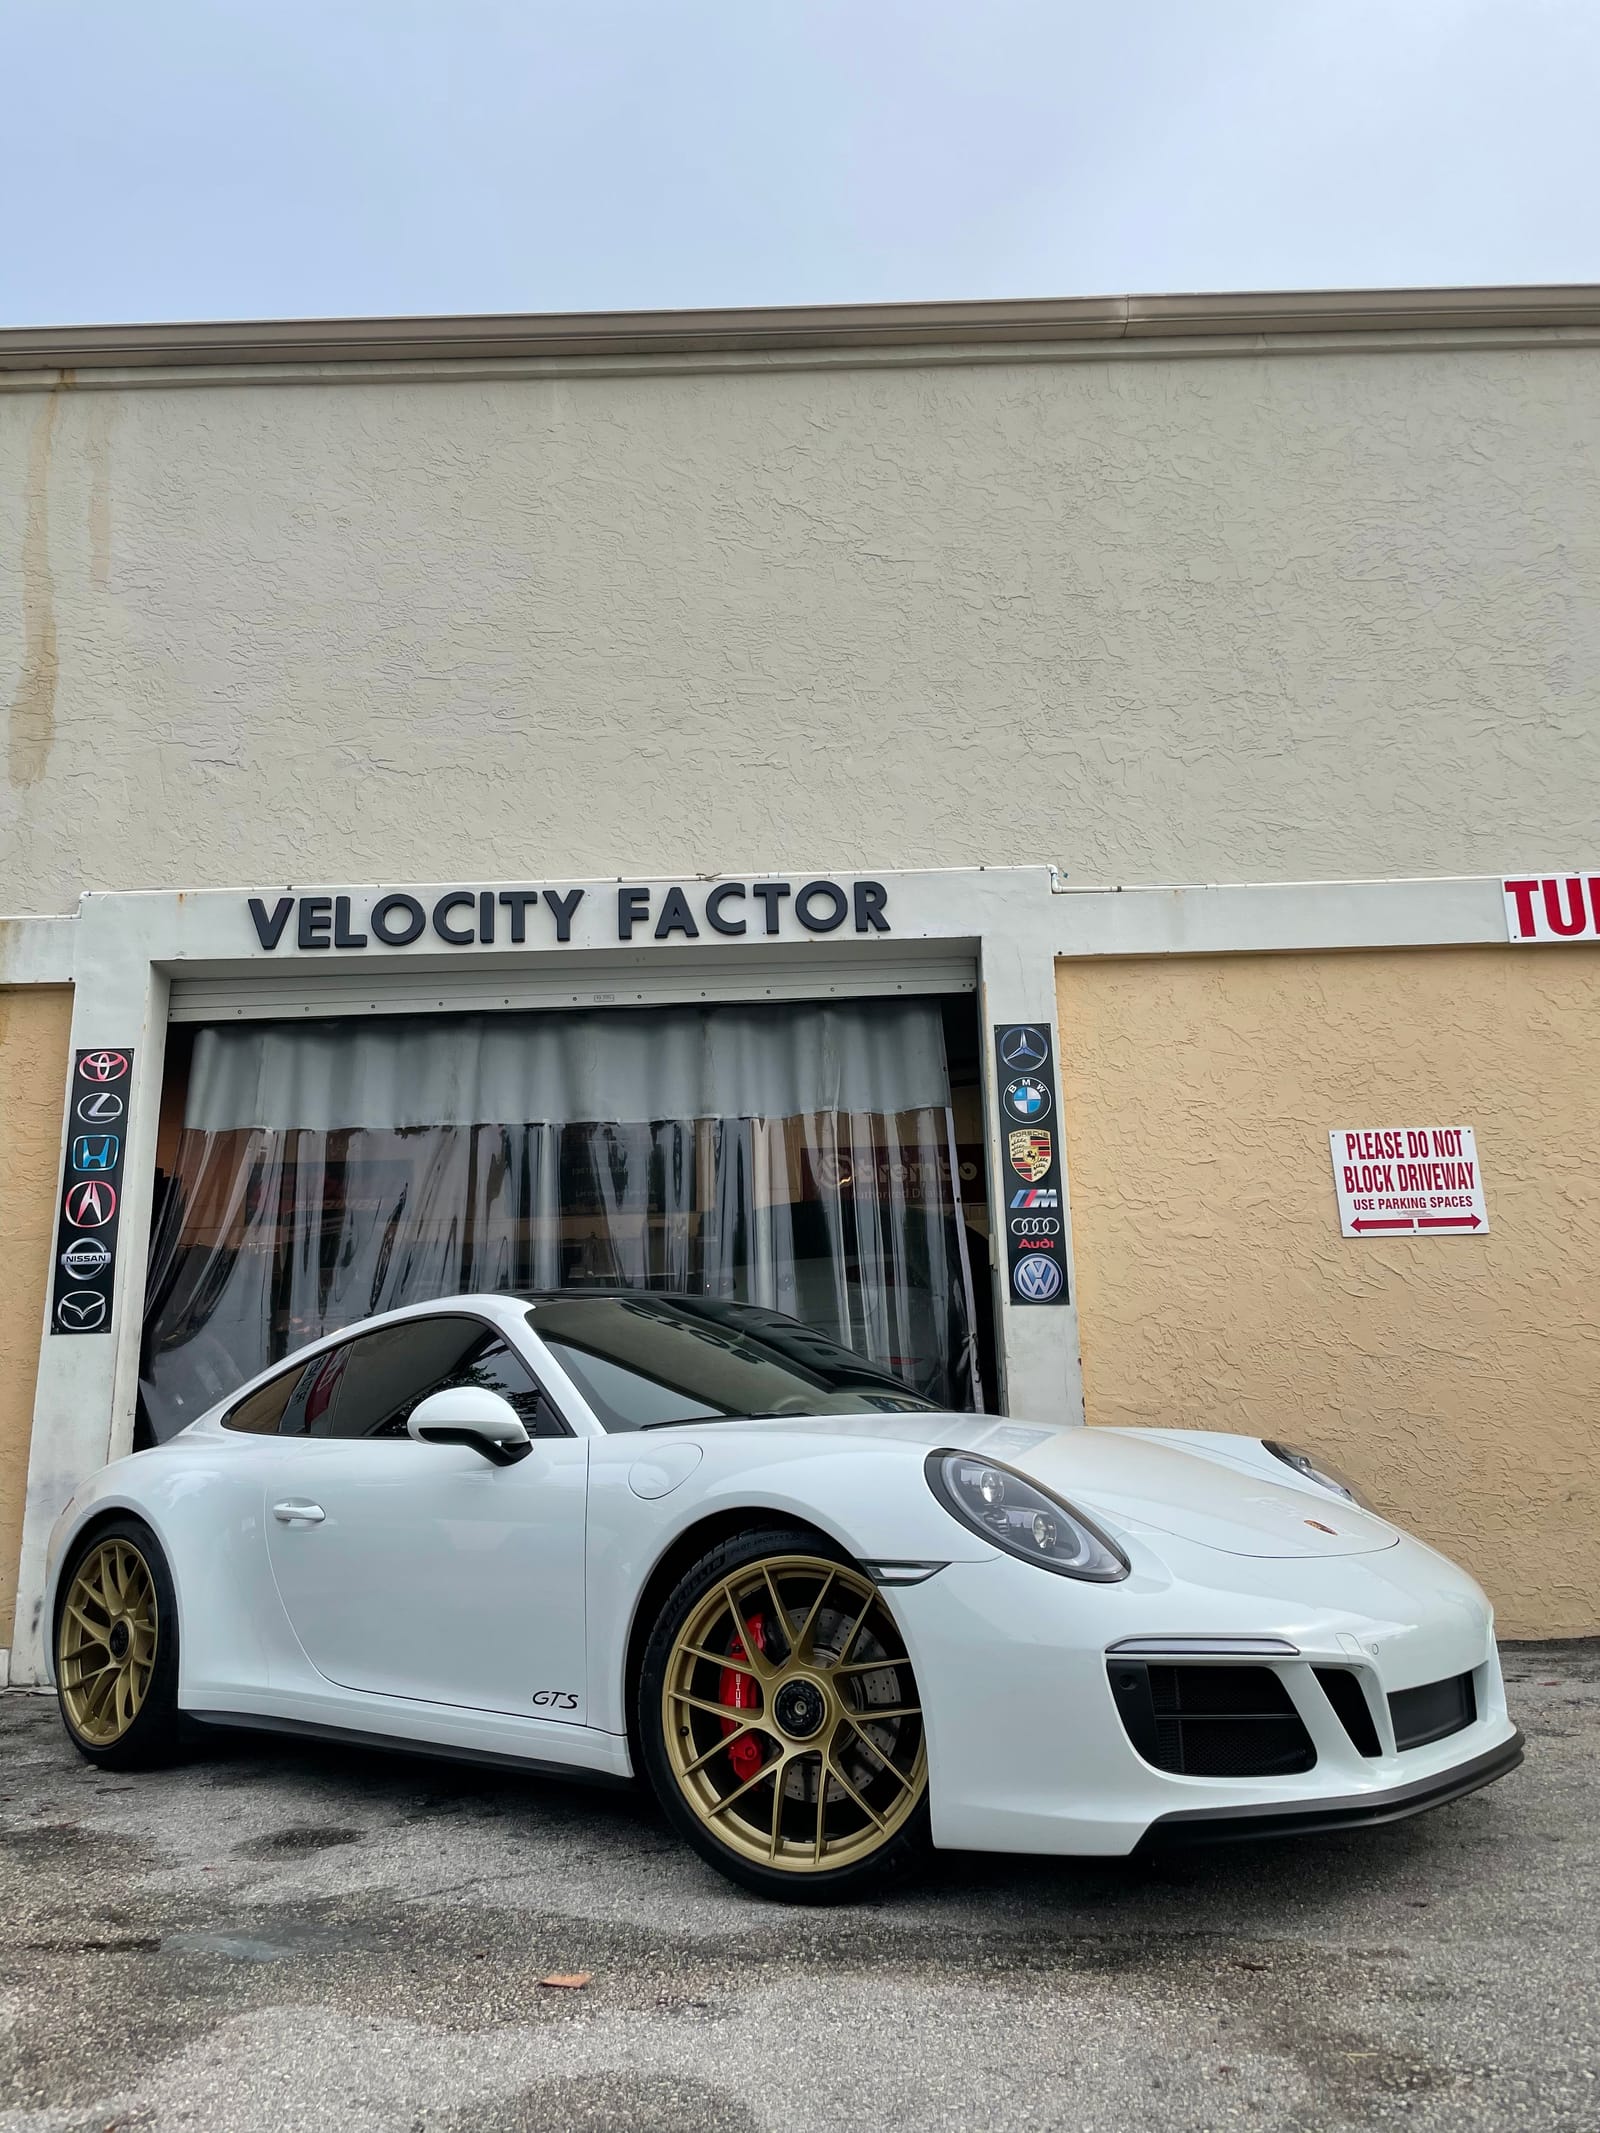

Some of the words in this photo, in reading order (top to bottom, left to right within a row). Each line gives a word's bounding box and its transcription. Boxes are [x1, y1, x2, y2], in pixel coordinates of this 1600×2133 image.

[248, 888, 584, 950] VELOCITY
[617, 880, 891, 940] FACTOR
[1008, 1078, 1047, 1095] BMW
[1010, 1130, 1049, 1139] PORSCHE
[1345, 1130, 1405, 1160] PLEASE
[1406, 1130, 1429, 1159] DO
[1433, 1129, 1463, 1158] NOT
[1343, 1164, 1396, 1194] BLOCK
[1397, 1162, 1475, 1192] DRIVEWAY
[1353, 1199, 1375, 1211] USE
[1378, 1197, 1427, 1211] PARKING
[1430, 1195, 1473, 1209] SPACES
[1018, 1238, 1054, 1249] Audi
[66, 1255, 106, 1263] NISSAN
[532, 1690, 580, 1710] GTS
